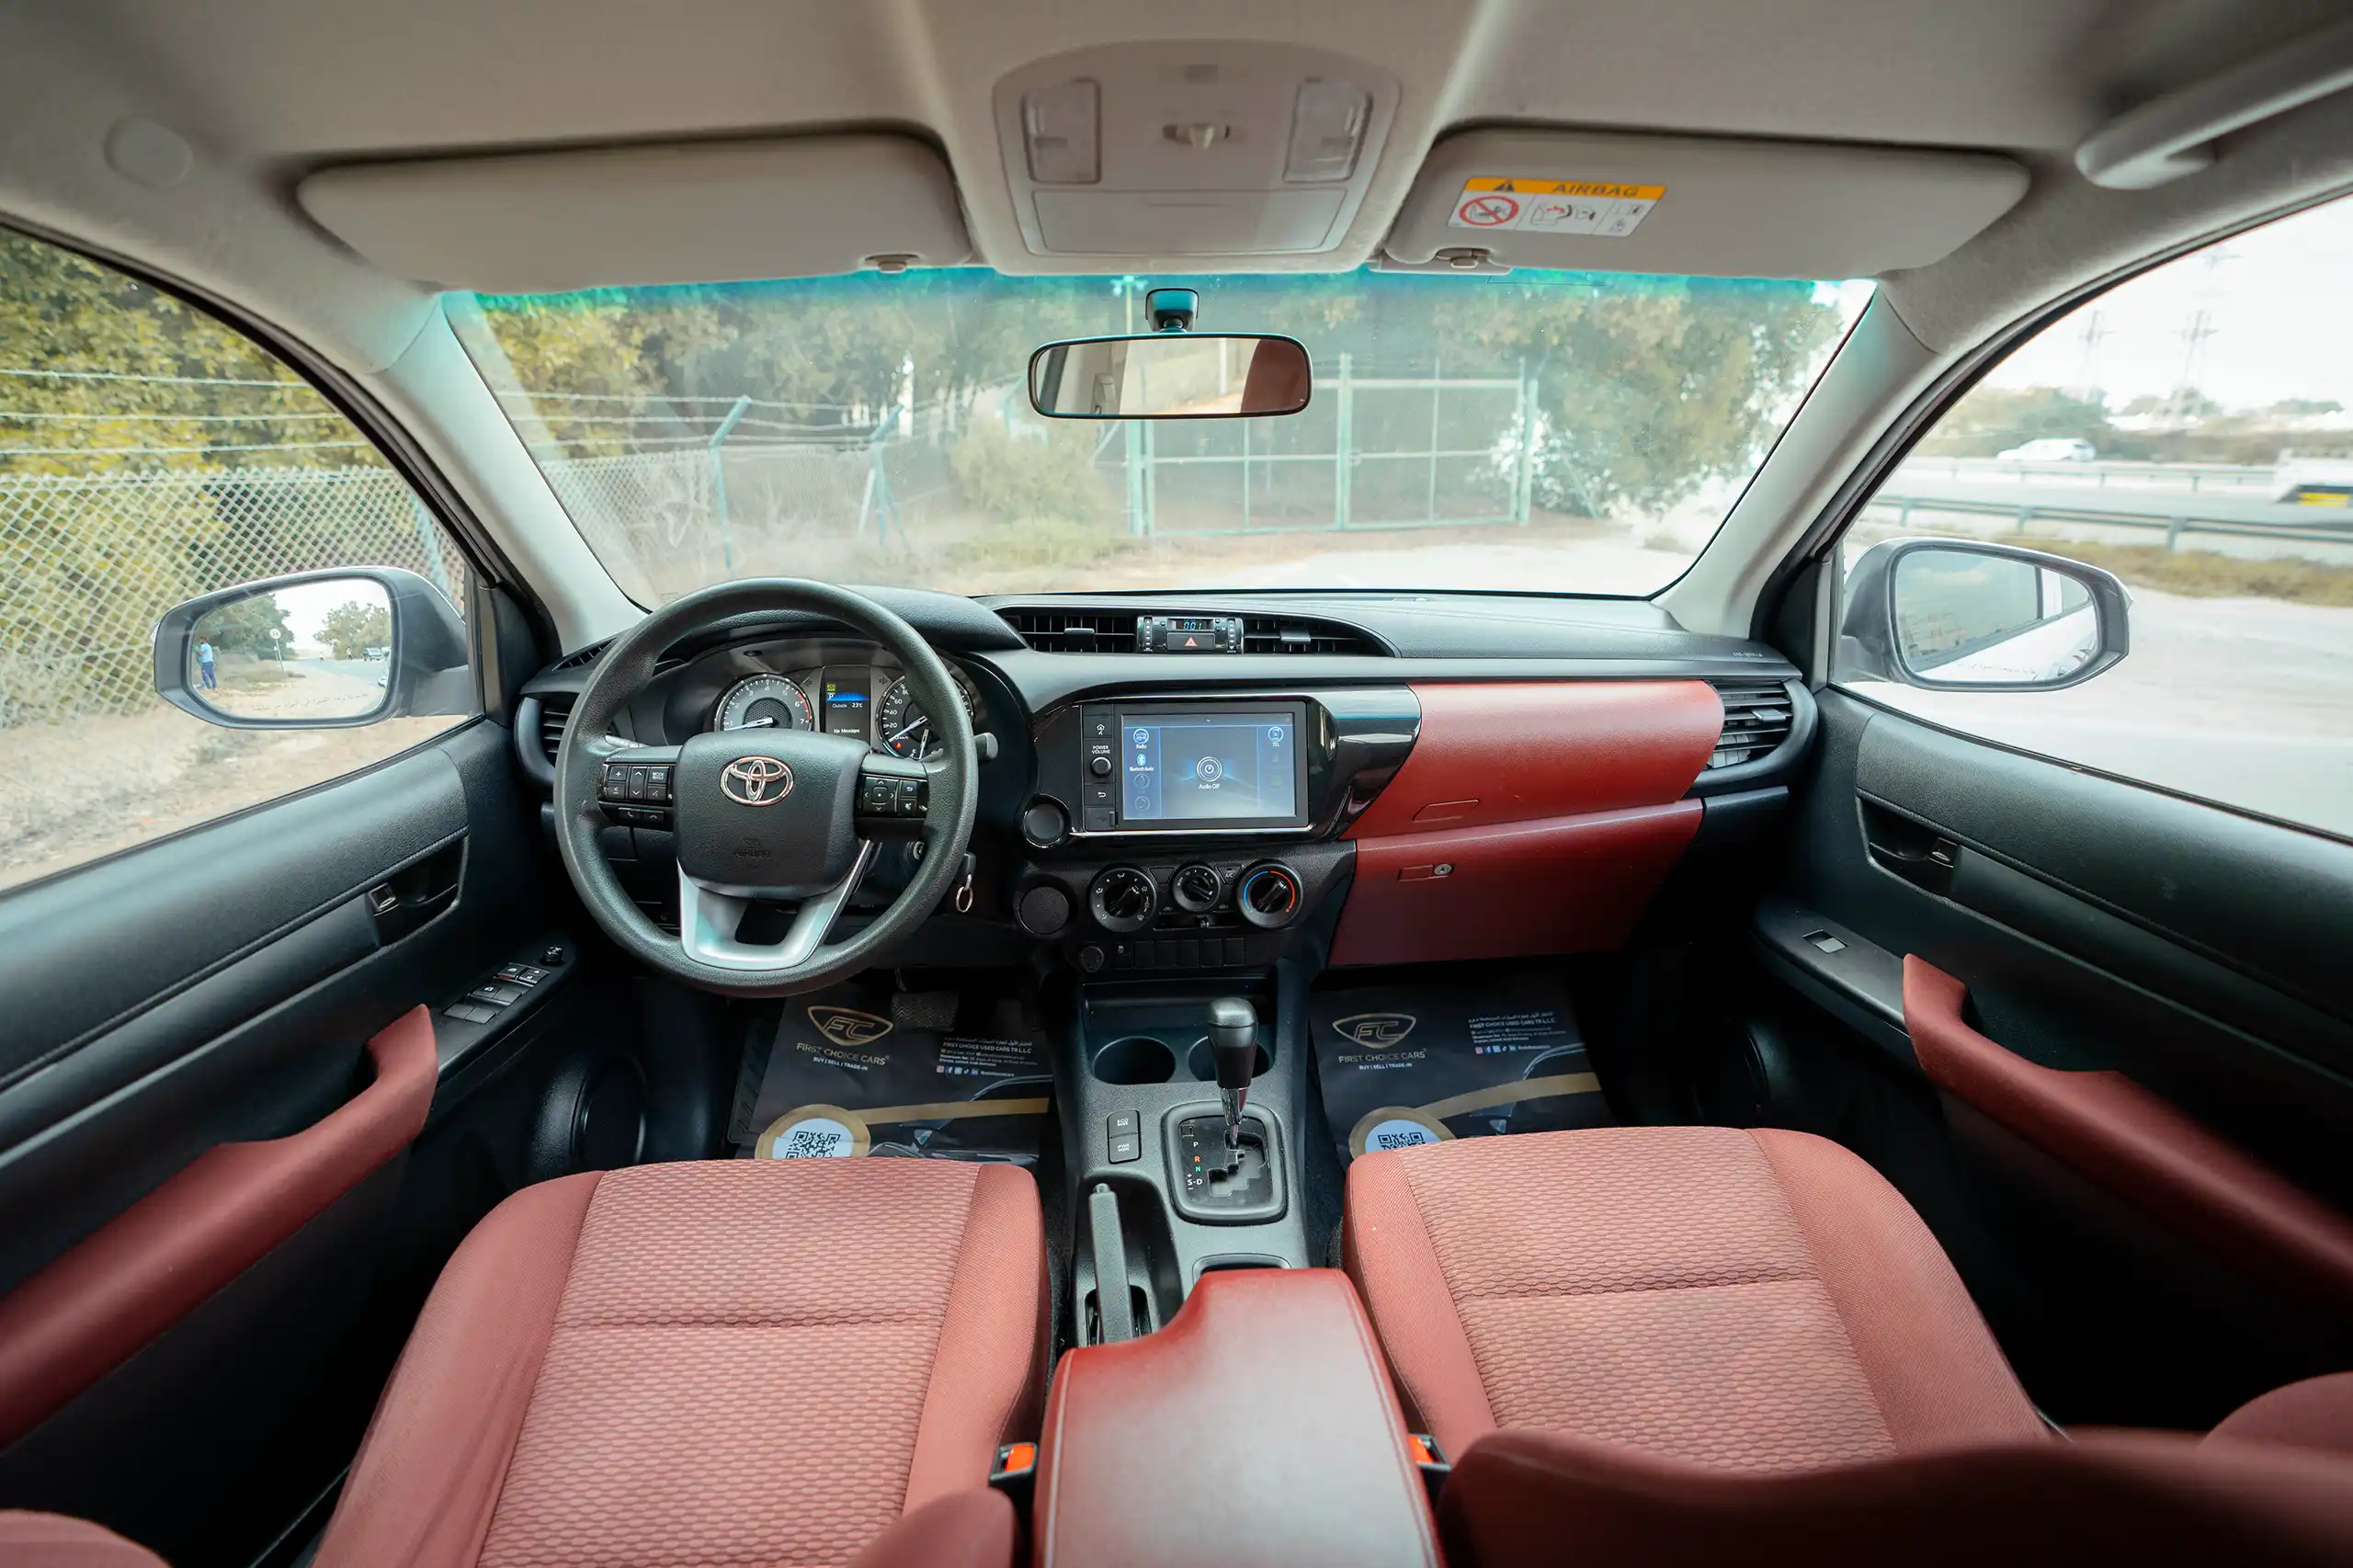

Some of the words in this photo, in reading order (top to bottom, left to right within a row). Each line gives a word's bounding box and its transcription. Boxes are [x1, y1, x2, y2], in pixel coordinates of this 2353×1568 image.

[1552, 183, 1639, 197] AIRBAG
[796, 1042, 823, 1055] FIRST
[824, 1048, 859, 1062] CHOICE
[861, 1055, 886, 1066] CARS
[1338, 1055, 1362, 1063] FIRST
[1365, 1052, 1398, 1062] CHOICE
[1401, 1051, 1425, 1060] CARS
[844, 1062, 869, 1071] TRADE-IN
